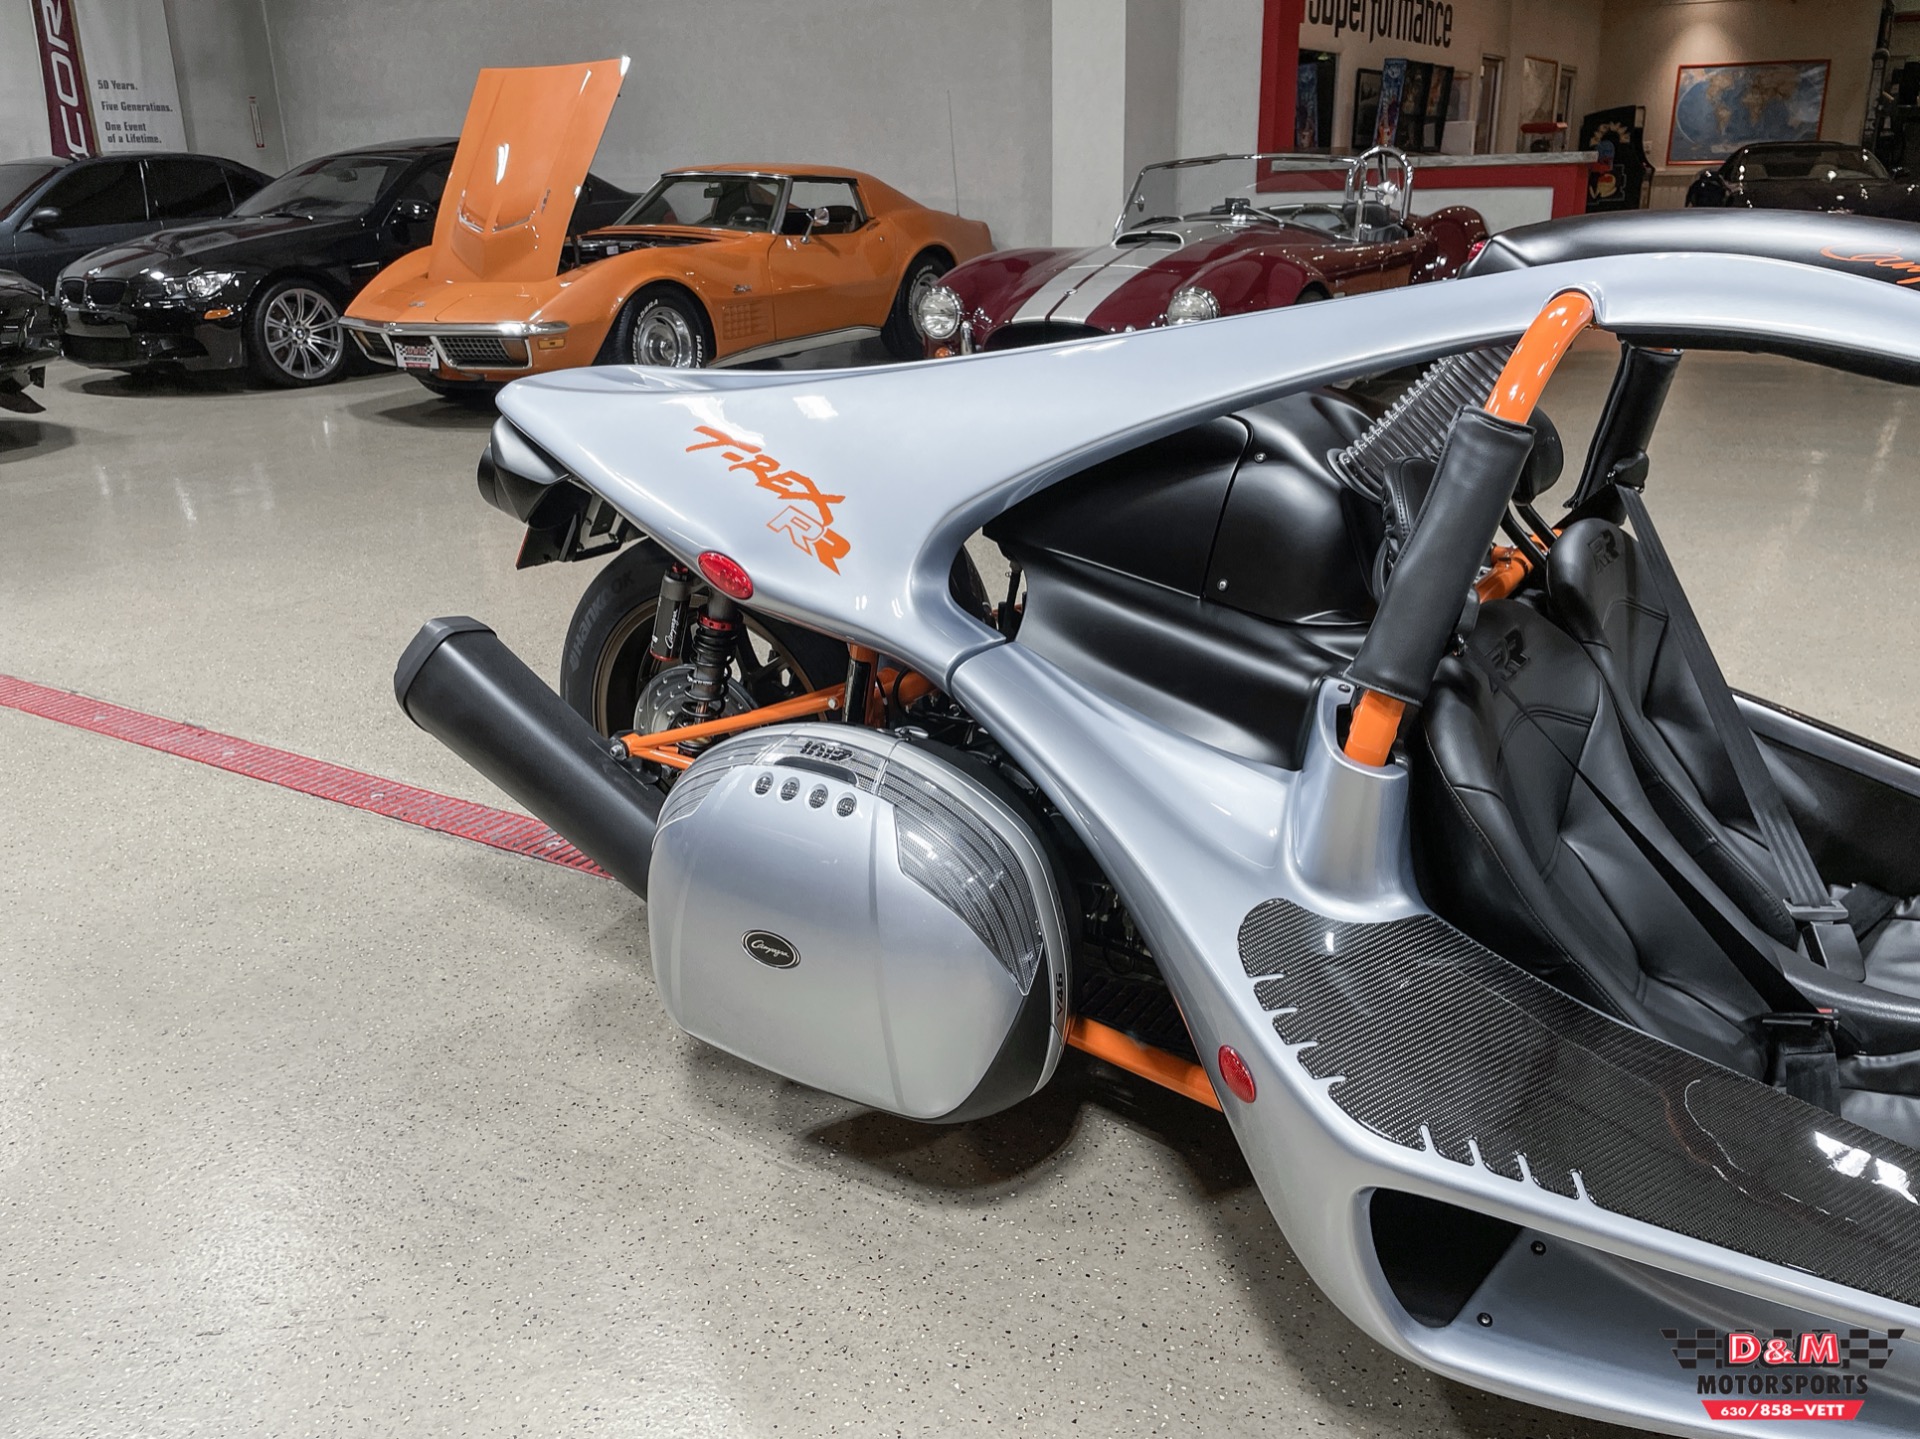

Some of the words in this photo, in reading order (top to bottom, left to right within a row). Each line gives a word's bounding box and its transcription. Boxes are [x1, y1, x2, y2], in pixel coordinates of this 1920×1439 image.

[98, 80, 109, 90] 50
[111, 80, 138, 91] Years.
[101, 101, 119, 111] Five
[121, 101, 173, 112] Generations.
[105, 121, 121, 131] One
[124, 121, 146, 132] Event
[107, 133, 116, 143] of
[118, 134, 124, 143] a
[126, 133, 162, 144] Lifetime.
[695, 334, 703, 368] RADIA
